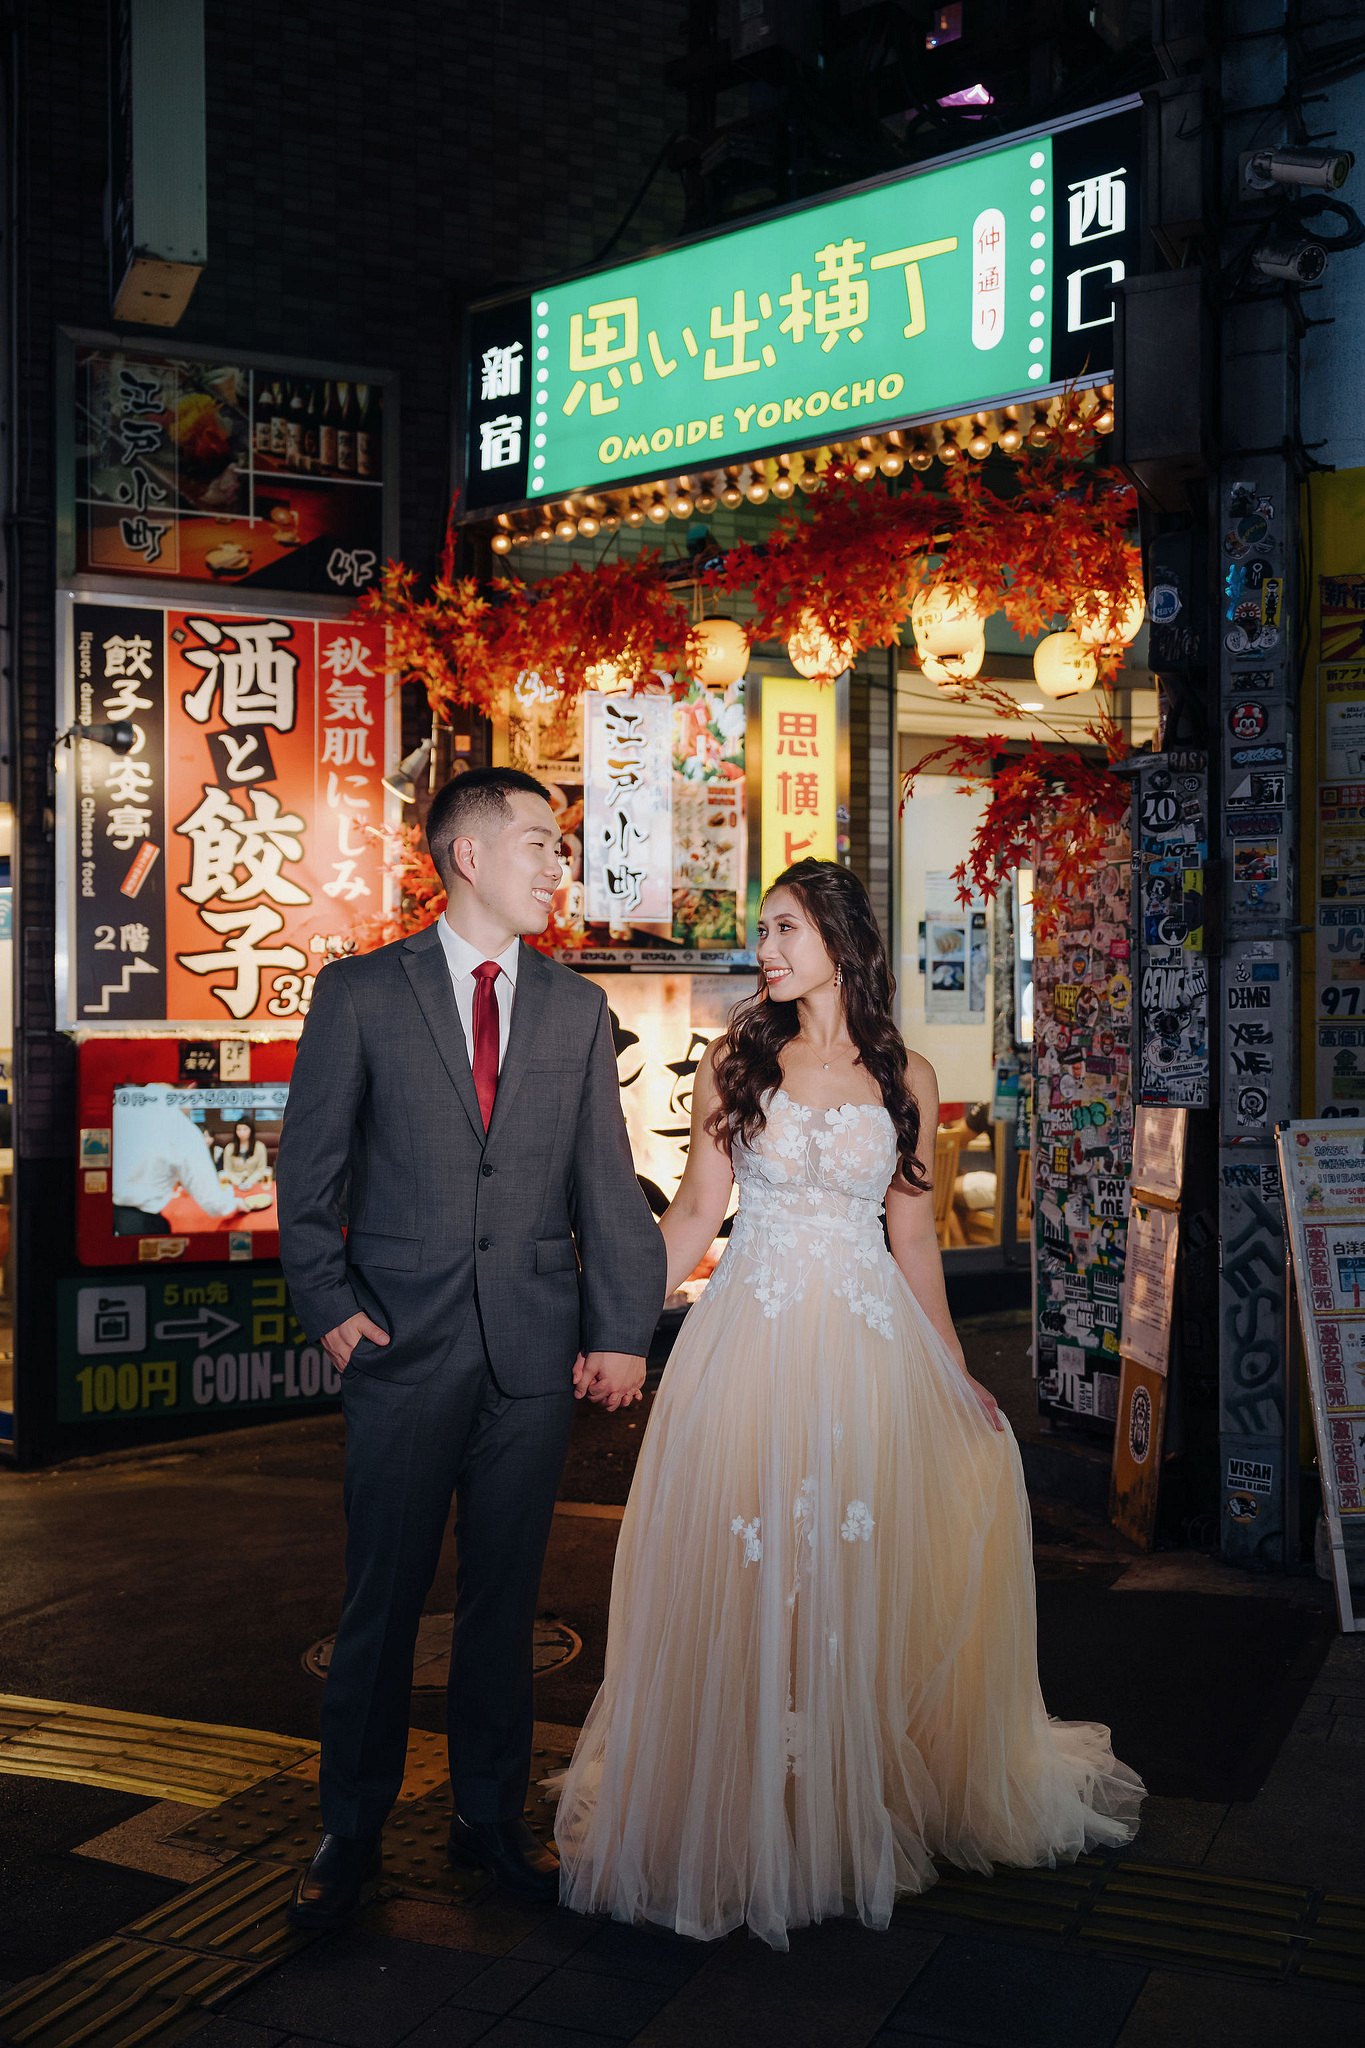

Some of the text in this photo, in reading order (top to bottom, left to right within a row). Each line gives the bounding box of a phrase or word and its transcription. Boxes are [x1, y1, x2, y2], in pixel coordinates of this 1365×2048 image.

[978, 226, 1000, 331] 仲通り
[1067, 166, 1127, 332] 西口
[562, 236, 959, 417] 思い出横丁
[479, 340, 525, 472] 新宿
[598, 372, 905, 464] OMOIDE YOKOCHO
[118, 369, 171, 563] 江戸小町
[81, 797, 96, 858] Chinese
[175, 617, 312, 1019] 酒と餃子
[601, 703, 650, 913] 江戸小町
[81, 860, 96, 897] food
[94, 923, 150, 954] 2階
[1098, 1180, 1126, 1197] PAY
[1100, 1199, 1124, 1216] ME
[76, 1360, 178, 1413] 100円
[1227, 1478, 1246, 1488] MADE
[1253, 1481, 1271, 1493] LOOK
[1229, 1459, 1272, 1481] VISAH
